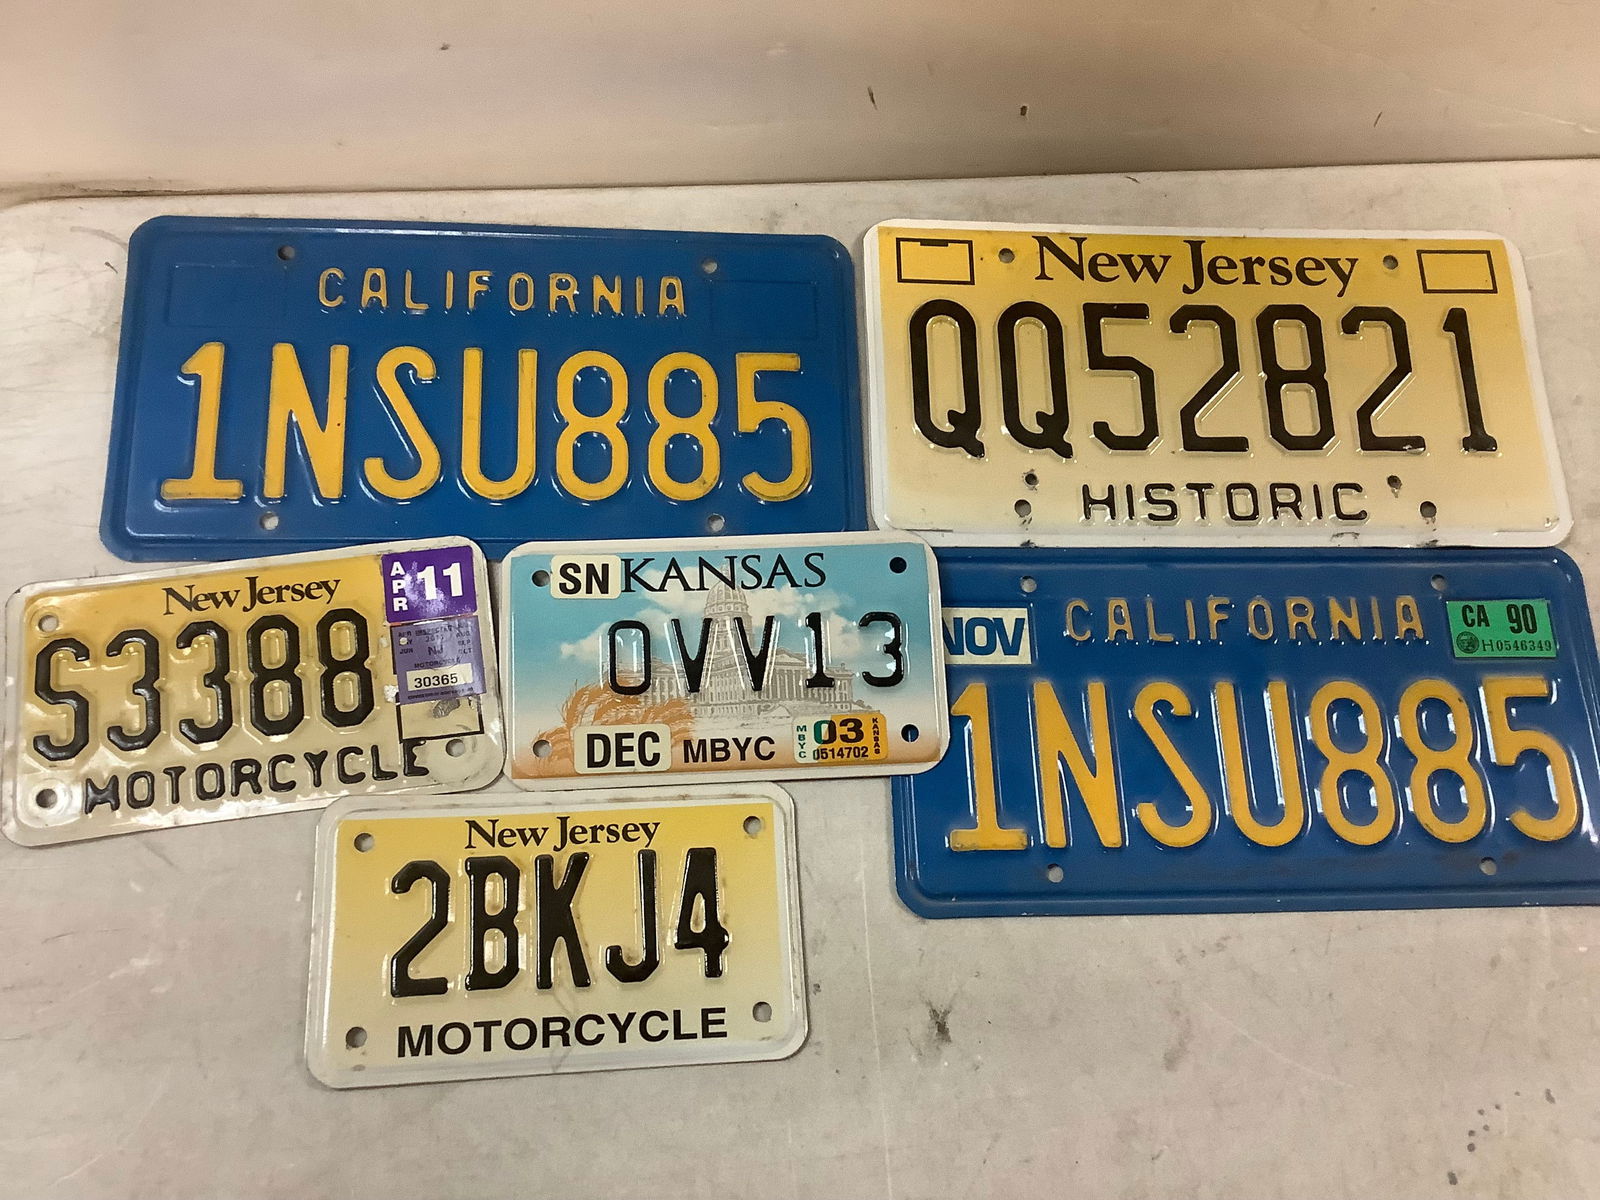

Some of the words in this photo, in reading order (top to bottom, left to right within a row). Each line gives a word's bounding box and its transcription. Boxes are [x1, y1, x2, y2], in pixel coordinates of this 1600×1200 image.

[1033, 235, 1172, 282] New
[1182, 240, 1359, 298] Jersey
[317, 266, 688, 315] CALIFORNIA
[908, 299, 1497, 459] QQ52821
[158, 340, 813, 503] 1NSU885
[1080, 480, 1367, 522] HISTORIC
[390, 561, 409, 612] APR
[416, 562, 464, 601] 11
[558, 562, 611, 596] SN
[621, 552, 827, 594] KANSAS
[162, 582, 244, 617] New
[244, 575, 341, 607] Jersey
[942, 617, 1025, 655] NOV
[1064, 594, 1427, 643] CALIFORNIA
[1461, 604, 1491, 628] CA
[1506, 603, 1538, 635] 90
[1481, 639, 1552, 652] H0546349
[31, 607, 375, 763] S3388
[414, 673, 458, 689] 30365
[586, 730, 662, 769] DEC
[682, 737, 776, 764] MBYC
[796, 725, 807, 759] MBYC
[813, 718, 864, 745] 03
[812, 746, 869, 761] 0514702
[948, 675, 1580, 850] 1NSU885
[84, 739, 431, 815] MOTORCYCLE
[464, 818, 549, 849] New
[552, 815, 661, 851] Jersey
[390, 846, 730, 999] 2BKJ4
[396, 1006, 728, 1058] MOTORCYCLE
